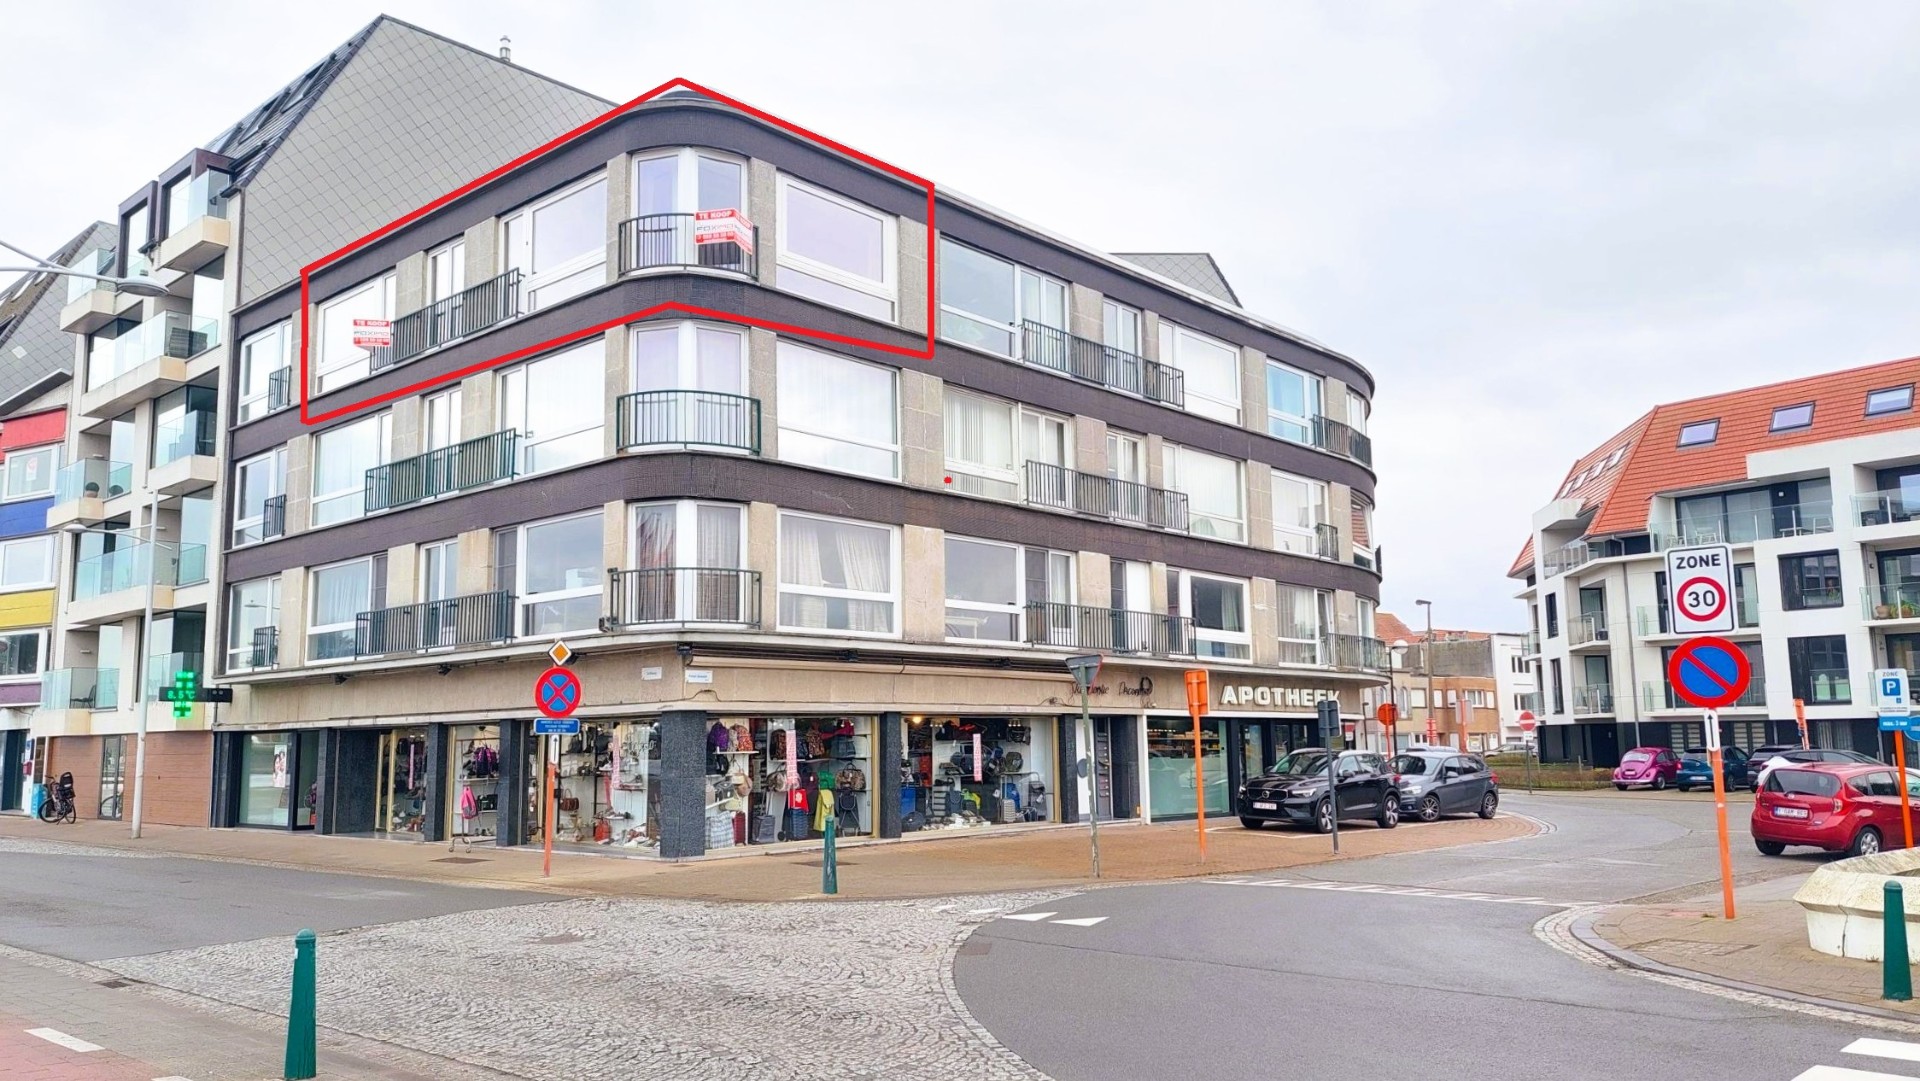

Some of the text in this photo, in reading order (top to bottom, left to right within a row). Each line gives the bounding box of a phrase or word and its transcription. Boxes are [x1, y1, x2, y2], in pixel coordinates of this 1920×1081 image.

[710, 210, 732, 219] KOOP
[1675, 553, 1721, 570] ZONE
[1687, 590, 1716, 608] 30
[1886, 680, 1897, 694] P
[1220, 685, 1340, 707] APOTHEEK
